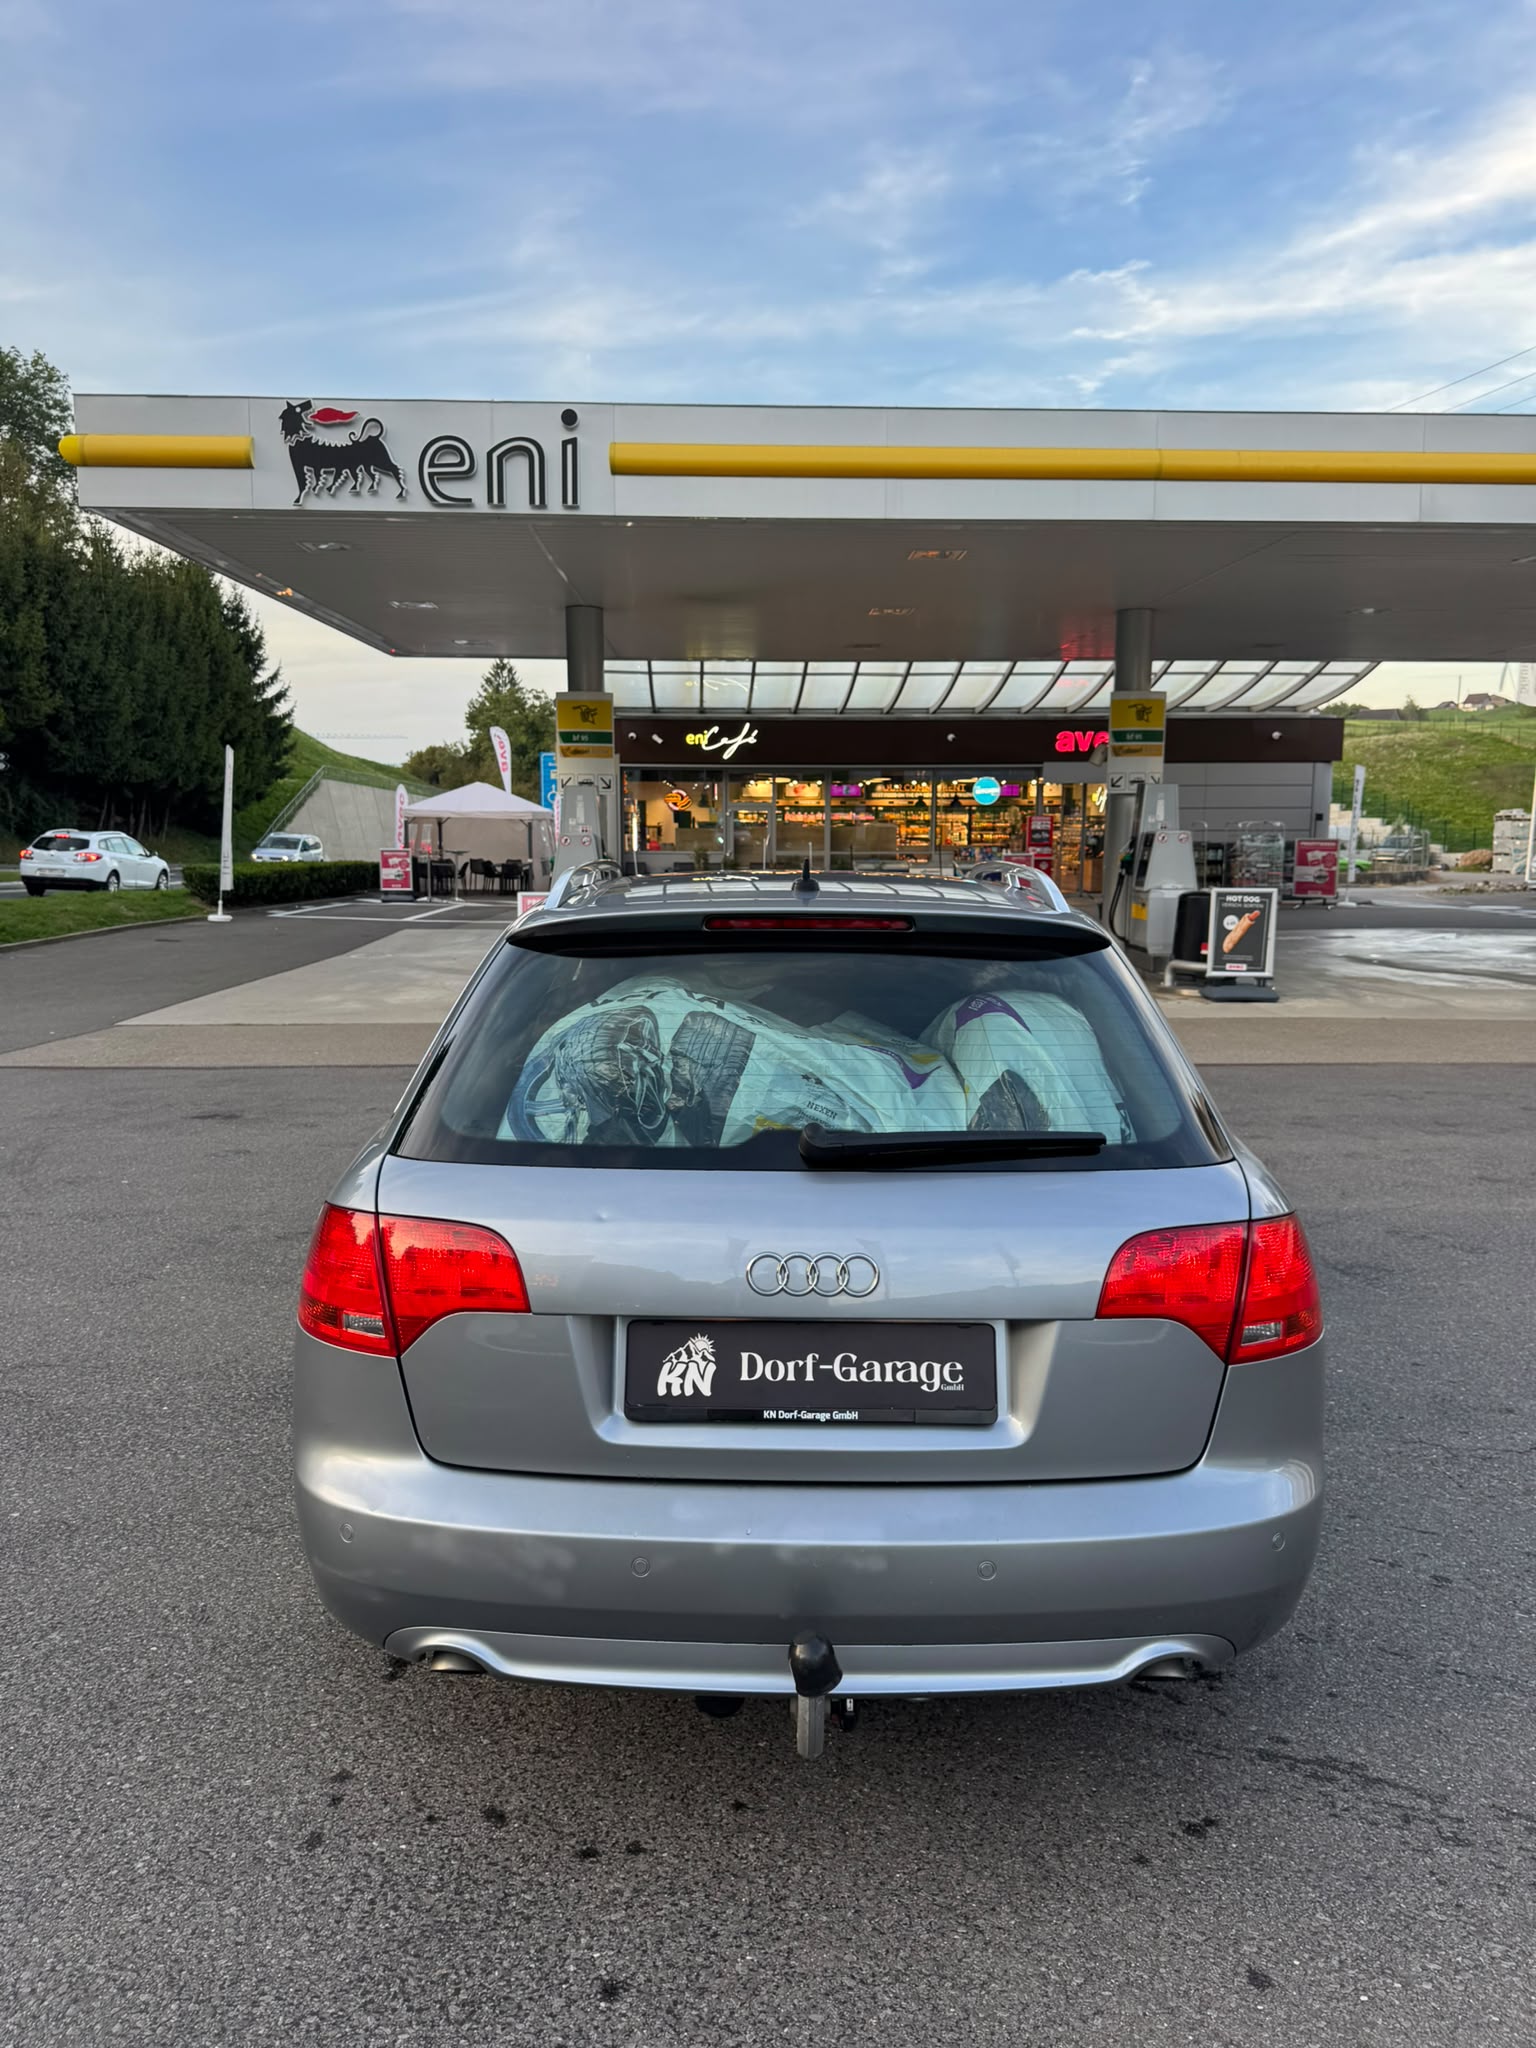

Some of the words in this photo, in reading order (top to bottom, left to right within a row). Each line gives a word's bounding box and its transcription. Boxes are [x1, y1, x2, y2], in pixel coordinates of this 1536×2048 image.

[418, 408, 578, 507] eni
[685, 730, 708, 745] eni
[1226, 895, 1242, 903] HOT
[806, 1101, 838, 1120] NEXEN
[657, 1361, 717, 1397] KN
[740, 1352, 964, 1392] Dorf-Garage
[940, 1383, 965, 1391] GmbH
[763, 1410, 777, 1419] KN
[778, 1410, 831, 1422] Dorf-Garage
[832, 1411, 859, 1420] GmbH
